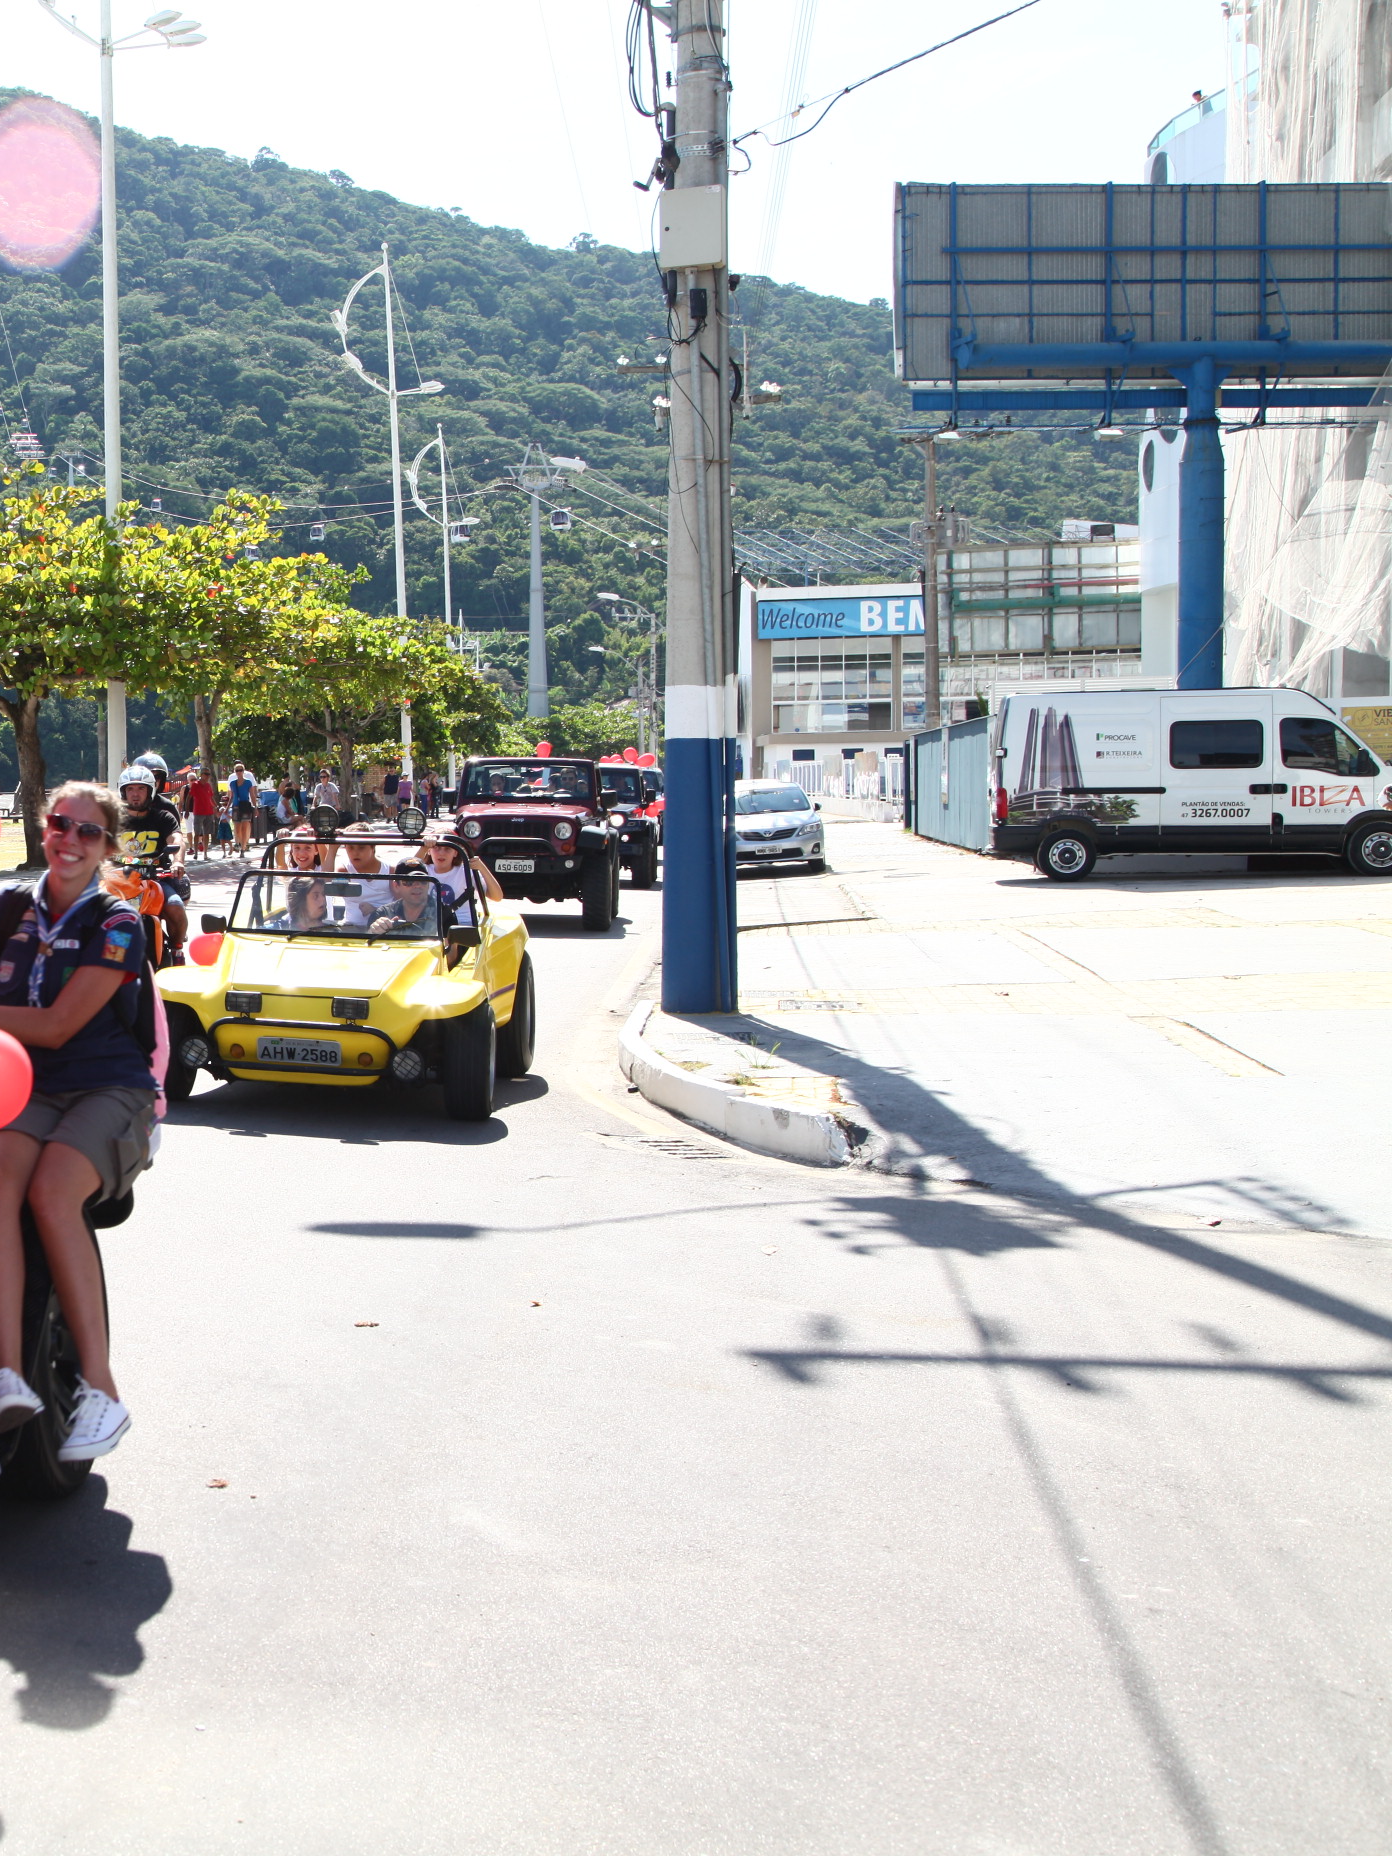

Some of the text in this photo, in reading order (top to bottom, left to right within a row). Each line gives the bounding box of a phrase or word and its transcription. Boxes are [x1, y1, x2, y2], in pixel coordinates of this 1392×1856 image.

[761, 607, 846, 630] Welcome
[1291, 785, 1366, 807] IBIZA
[1191, 808, 1251, 818] 3267.0007
